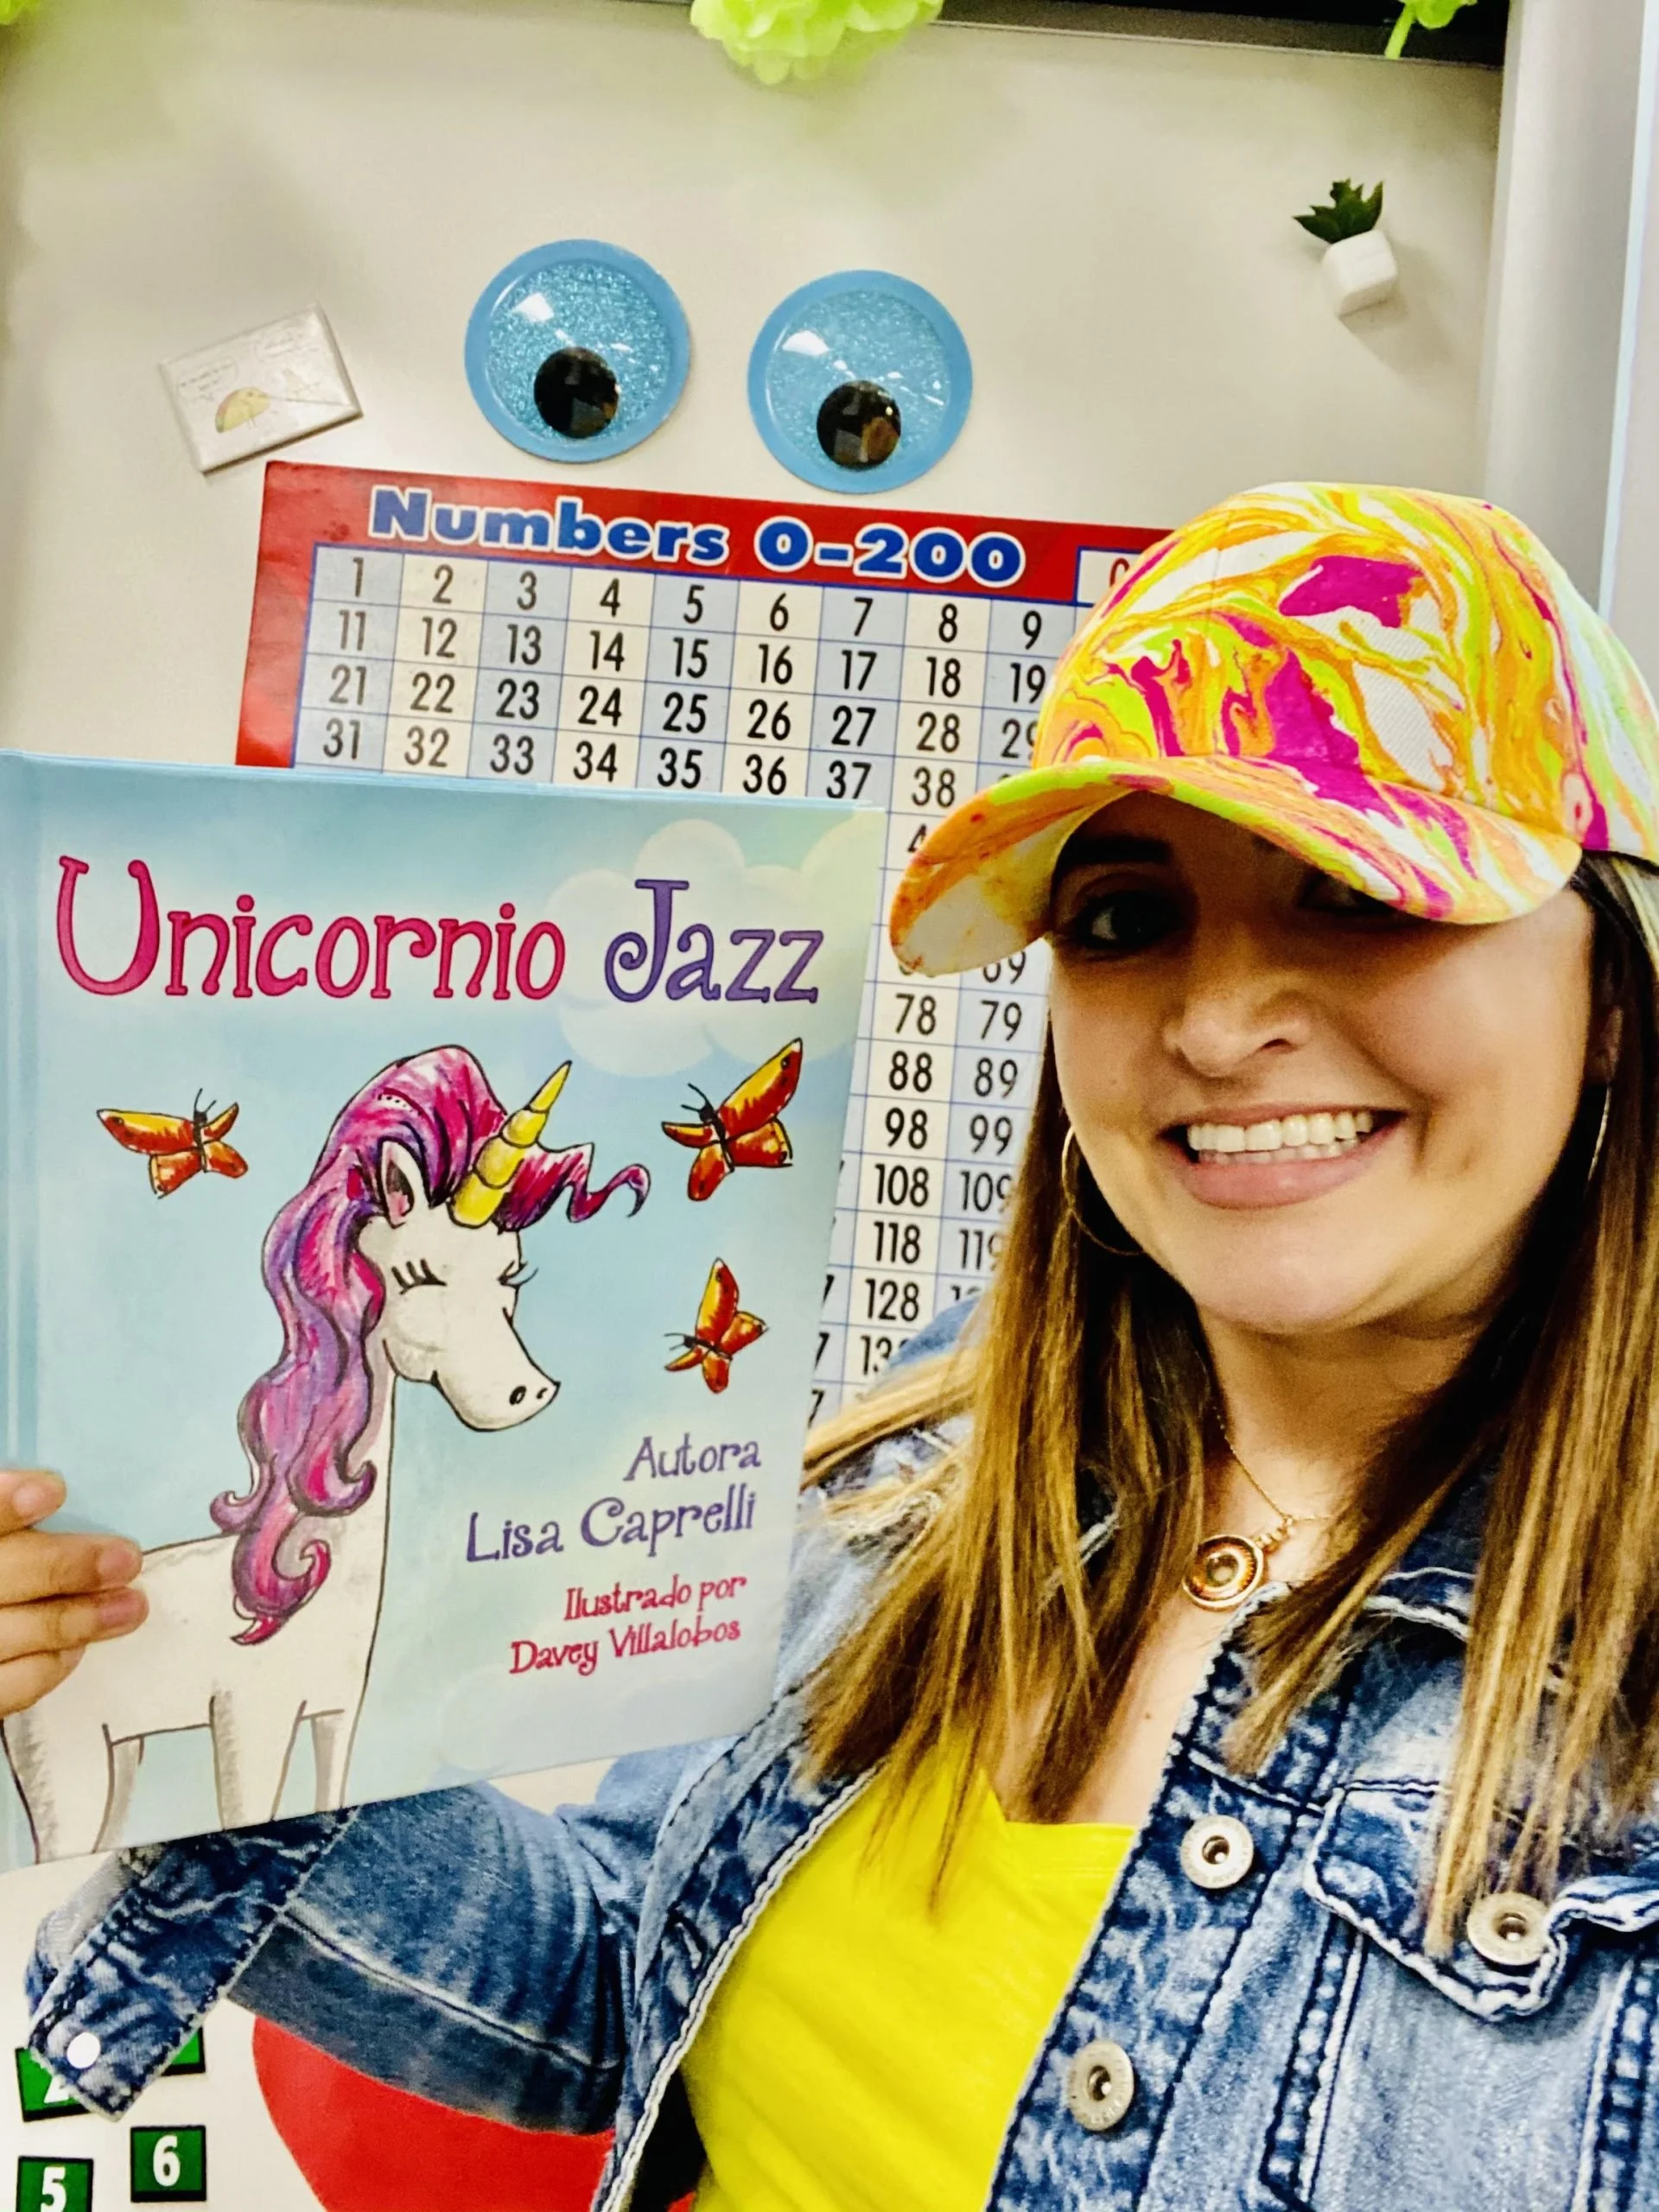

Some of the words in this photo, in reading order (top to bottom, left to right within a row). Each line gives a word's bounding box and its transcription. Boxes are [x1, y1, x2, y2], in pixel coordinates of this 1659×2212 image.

[370, 486, 728, 564] Numbers
[754, 516, 1026, 588] 0-200
[353, 556, 364, 597] 1
[433, 564, 454, 604] 2
[517, 571, 537, 610] 3
[600, 579, 620, 617] 4
[683, 585, 704, 624] 5
[770, 593, 789, 632] 6
[855, 597, 873, 636] 7
[938, 603, 957, 643] 8
[1023, 610, 1041, 650] 9
[339, 610, 366, 651] 11
[423, 617, 457, 658] 12
[508, 624, 541, 665] 13
[590, 631, 625, 671] 14
[673, 637, 709, 678] 15
[759, 644, 792, 684] 16
[842, 650, 877, 691] 17
[926, 657, 961, 697] 18
[1010, 663, 1046, 703] 19
[329, 664, 366, 705] 21
[410, 671, 454, 713] 22
[496, 678, 539, 720] 23
[578, 685, 621, 727] 24
[663, 692, 708, 734] 25
[747, 699, 791, 741] 26
[831, 705, 876, 747] 27
[917, 712, 960, 753] 28
[323, 719, 359, 760] 31
[404, 726, 449, 767] 32
[490, 734, 534, 775] 33
[574, 741, 617, 782] 34
[658, 747, 702, 789] 35
[743, 754, 786, 795] 36
[827, 761, 871, 799] 37
[912, 766, 955, 808] 38
[57, 855, 565, 1000] Unicornio
[605, 879, 823, 1003] Jazz
[896, 993, 936, 1035] 78
[982, 1000, 1022, 1041] 79
[889, 1051, 932, 1093] 88
[975, 1058, 1018, 1097] 89
[886, 1108, 927, 1149] 98
[970, 1115, 1012, 1155] 99
[875, 1164, 929, 1207] 108
[874, 1221, 920, 1264] 118
[866, 1279, 918, 1322] 128
[860, 1334, 909, 1376] 13
[623, 1433, 761, 1481] Autora
[467, 1512, 563, 1562] Lisa
[581, 1483, 757, 1557] Caprelli
[564, 1574, 691, 1621] Ilustrado
[697, 1576, 747, 1611] por
[509, 1640, 599, 1676] Davey
[608, 1615, 741, 1658] Villalobos
[153, 2134, 181, 2187] 6
[41, 2165, 67, 2212] 5
